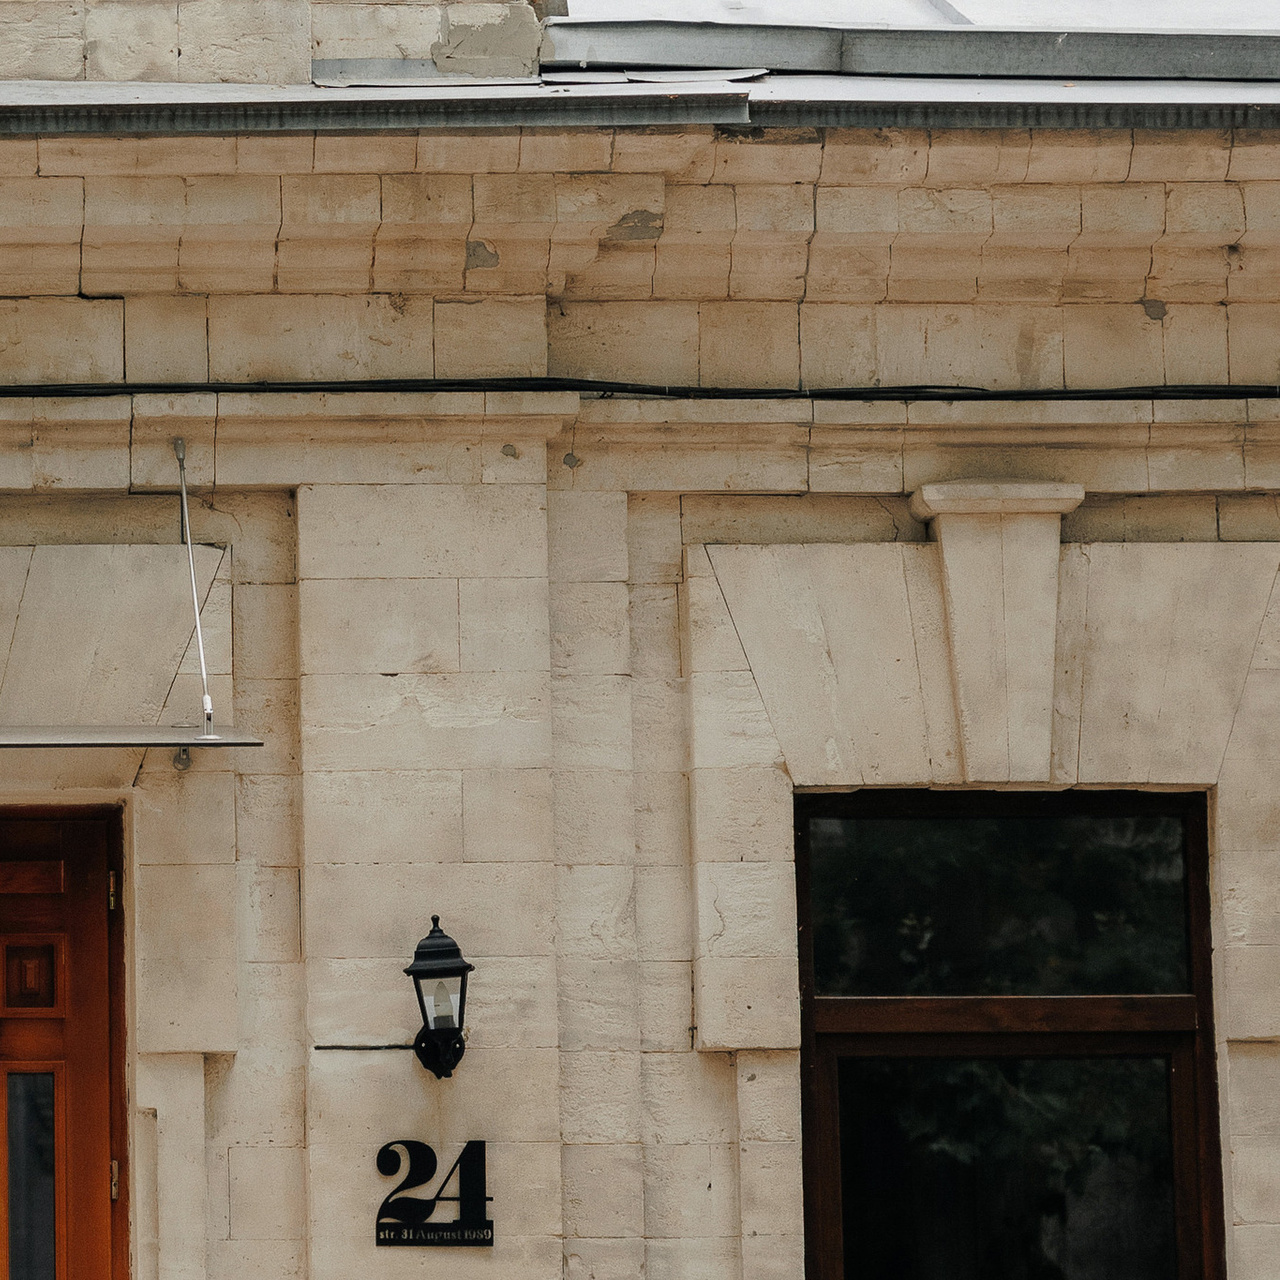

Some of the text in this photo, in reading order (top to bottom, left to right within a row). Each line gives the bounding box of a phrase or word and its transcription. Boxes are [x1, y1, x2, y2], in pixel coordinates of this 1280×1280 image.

[376, 1139, 494, 1223] 24
[401, 1228, 414, 1240] 31
[416, 1228, 462, 1243] August
[463, 1228, 492, 1240] 1989
